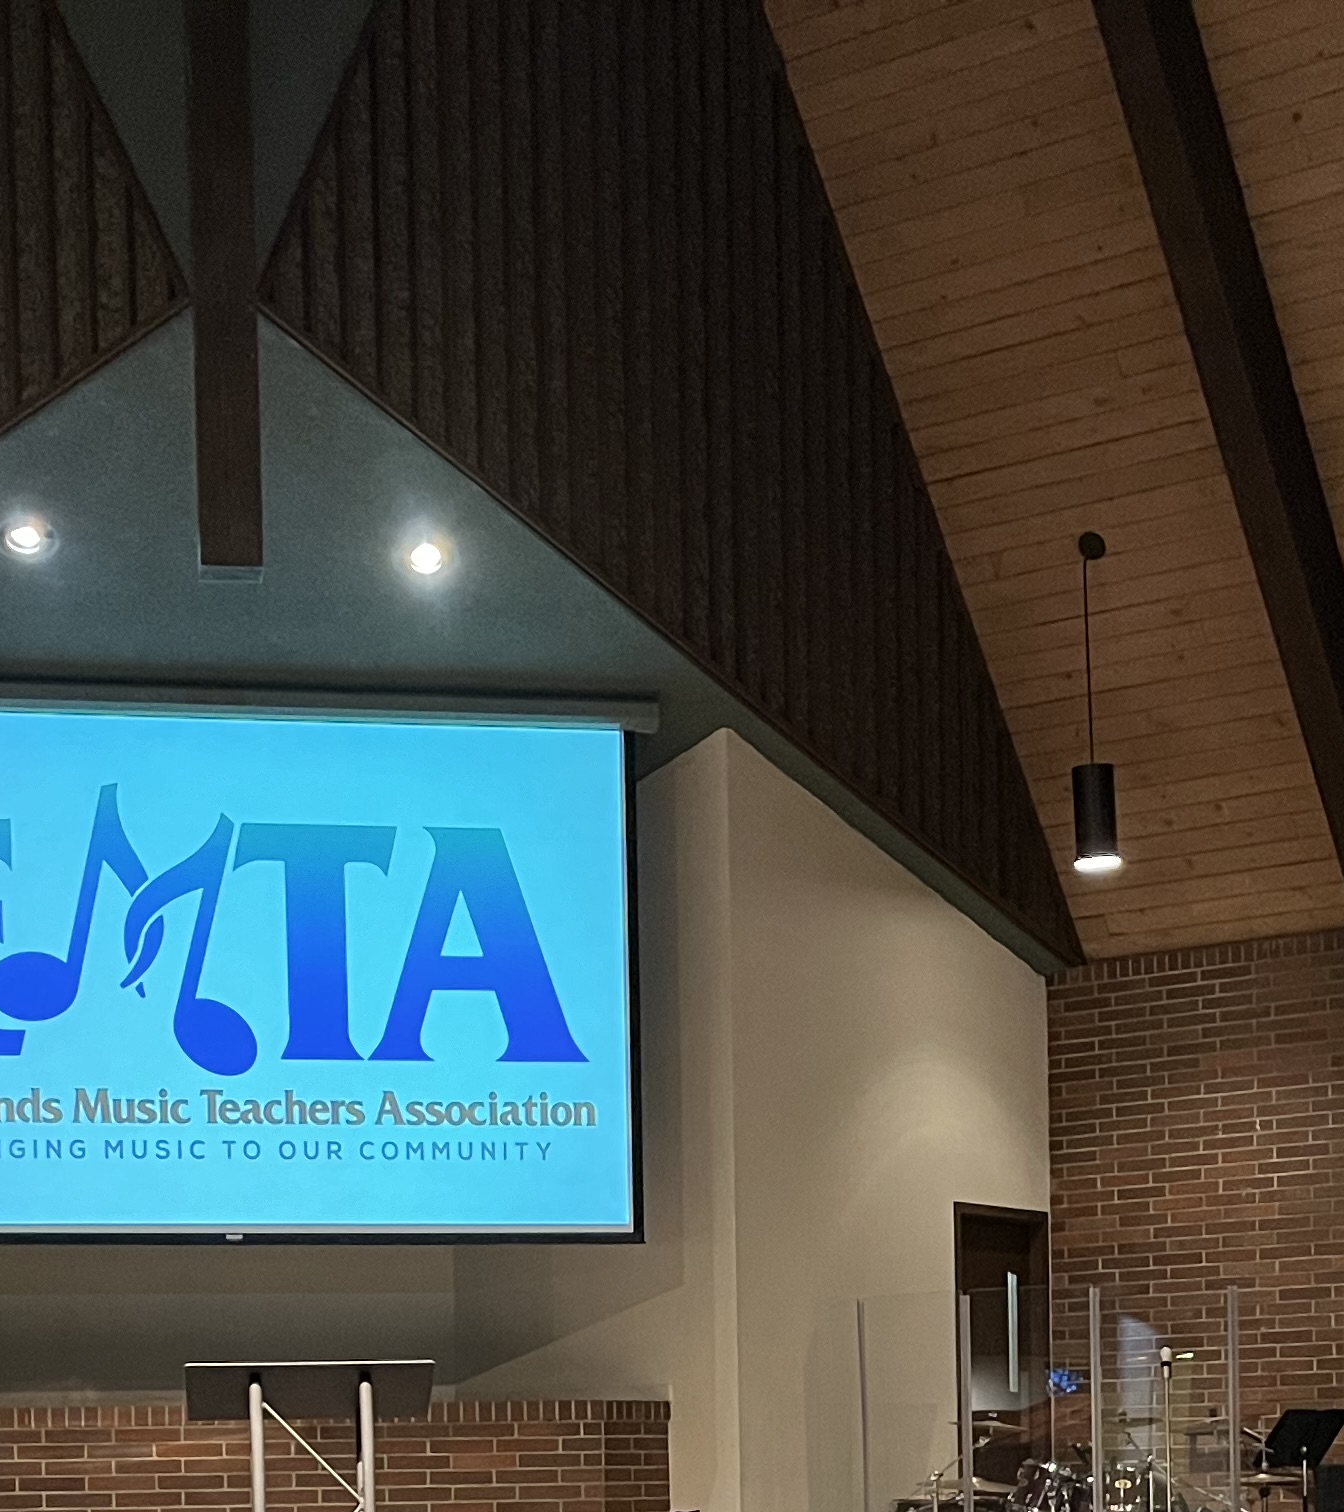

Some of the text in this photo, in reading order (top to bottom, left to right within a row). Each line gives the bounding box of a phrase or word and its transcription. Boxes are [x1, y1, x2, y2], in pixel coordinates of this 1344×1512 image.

[73, 1088, 192, 1125] Music
[200, 1090, 366, 1126] Teachers
[375, 1091, 597, 1127] Association
[104, 1139, 206, 1160] MUSIC
[222, 1140, 261, 1160] TO
[278, 1140, 343, 1160] OUR
[359, 1141, 553, 1161] COMMUNITY
